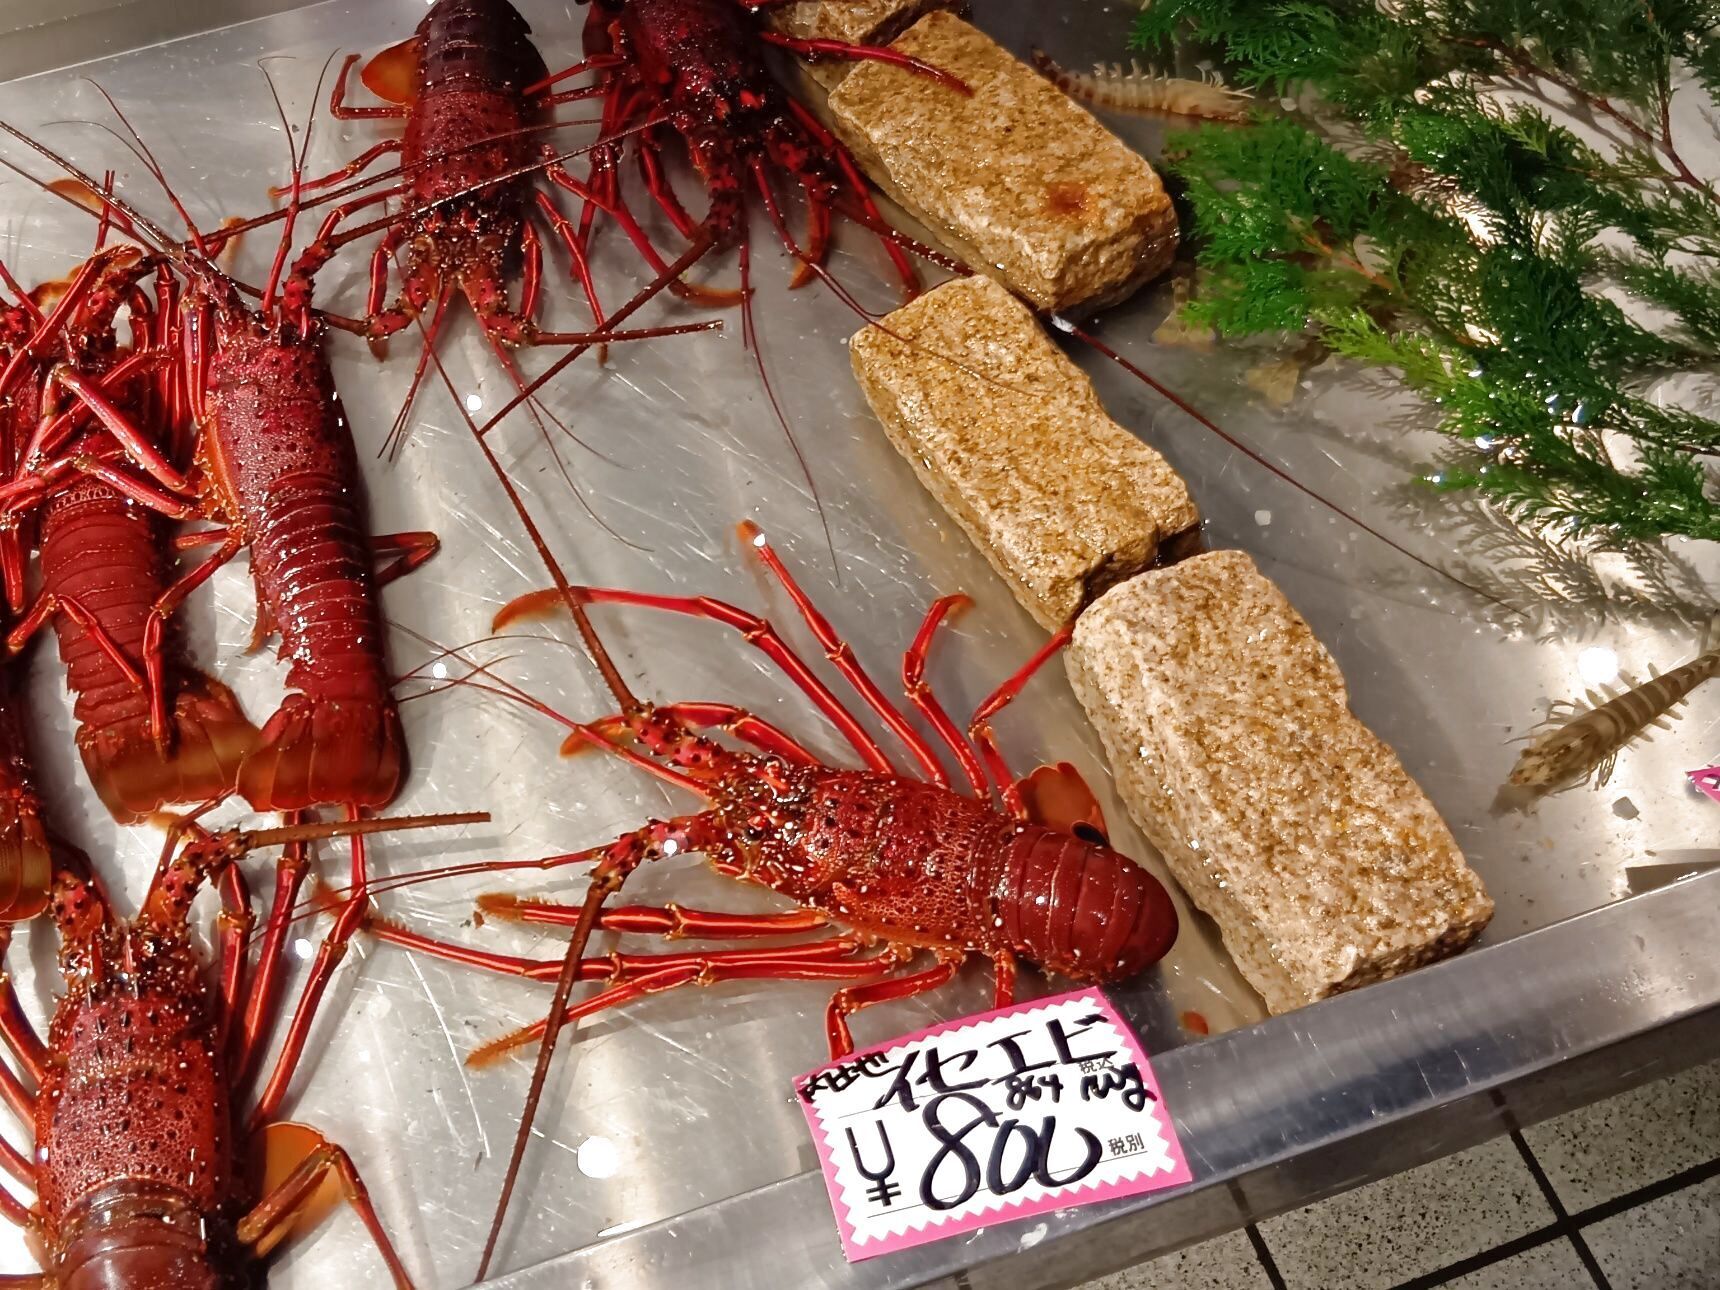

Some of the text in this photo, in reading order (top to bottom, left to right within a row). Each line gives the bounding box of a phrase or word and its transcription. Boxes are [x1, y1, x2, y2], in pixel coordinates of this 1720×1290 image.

[873, 1013, 1118, 1113] イセエビ
[1079, 1058, 1114, 1075] 税込
[1108, 1133, 1144, 1156] 税別
